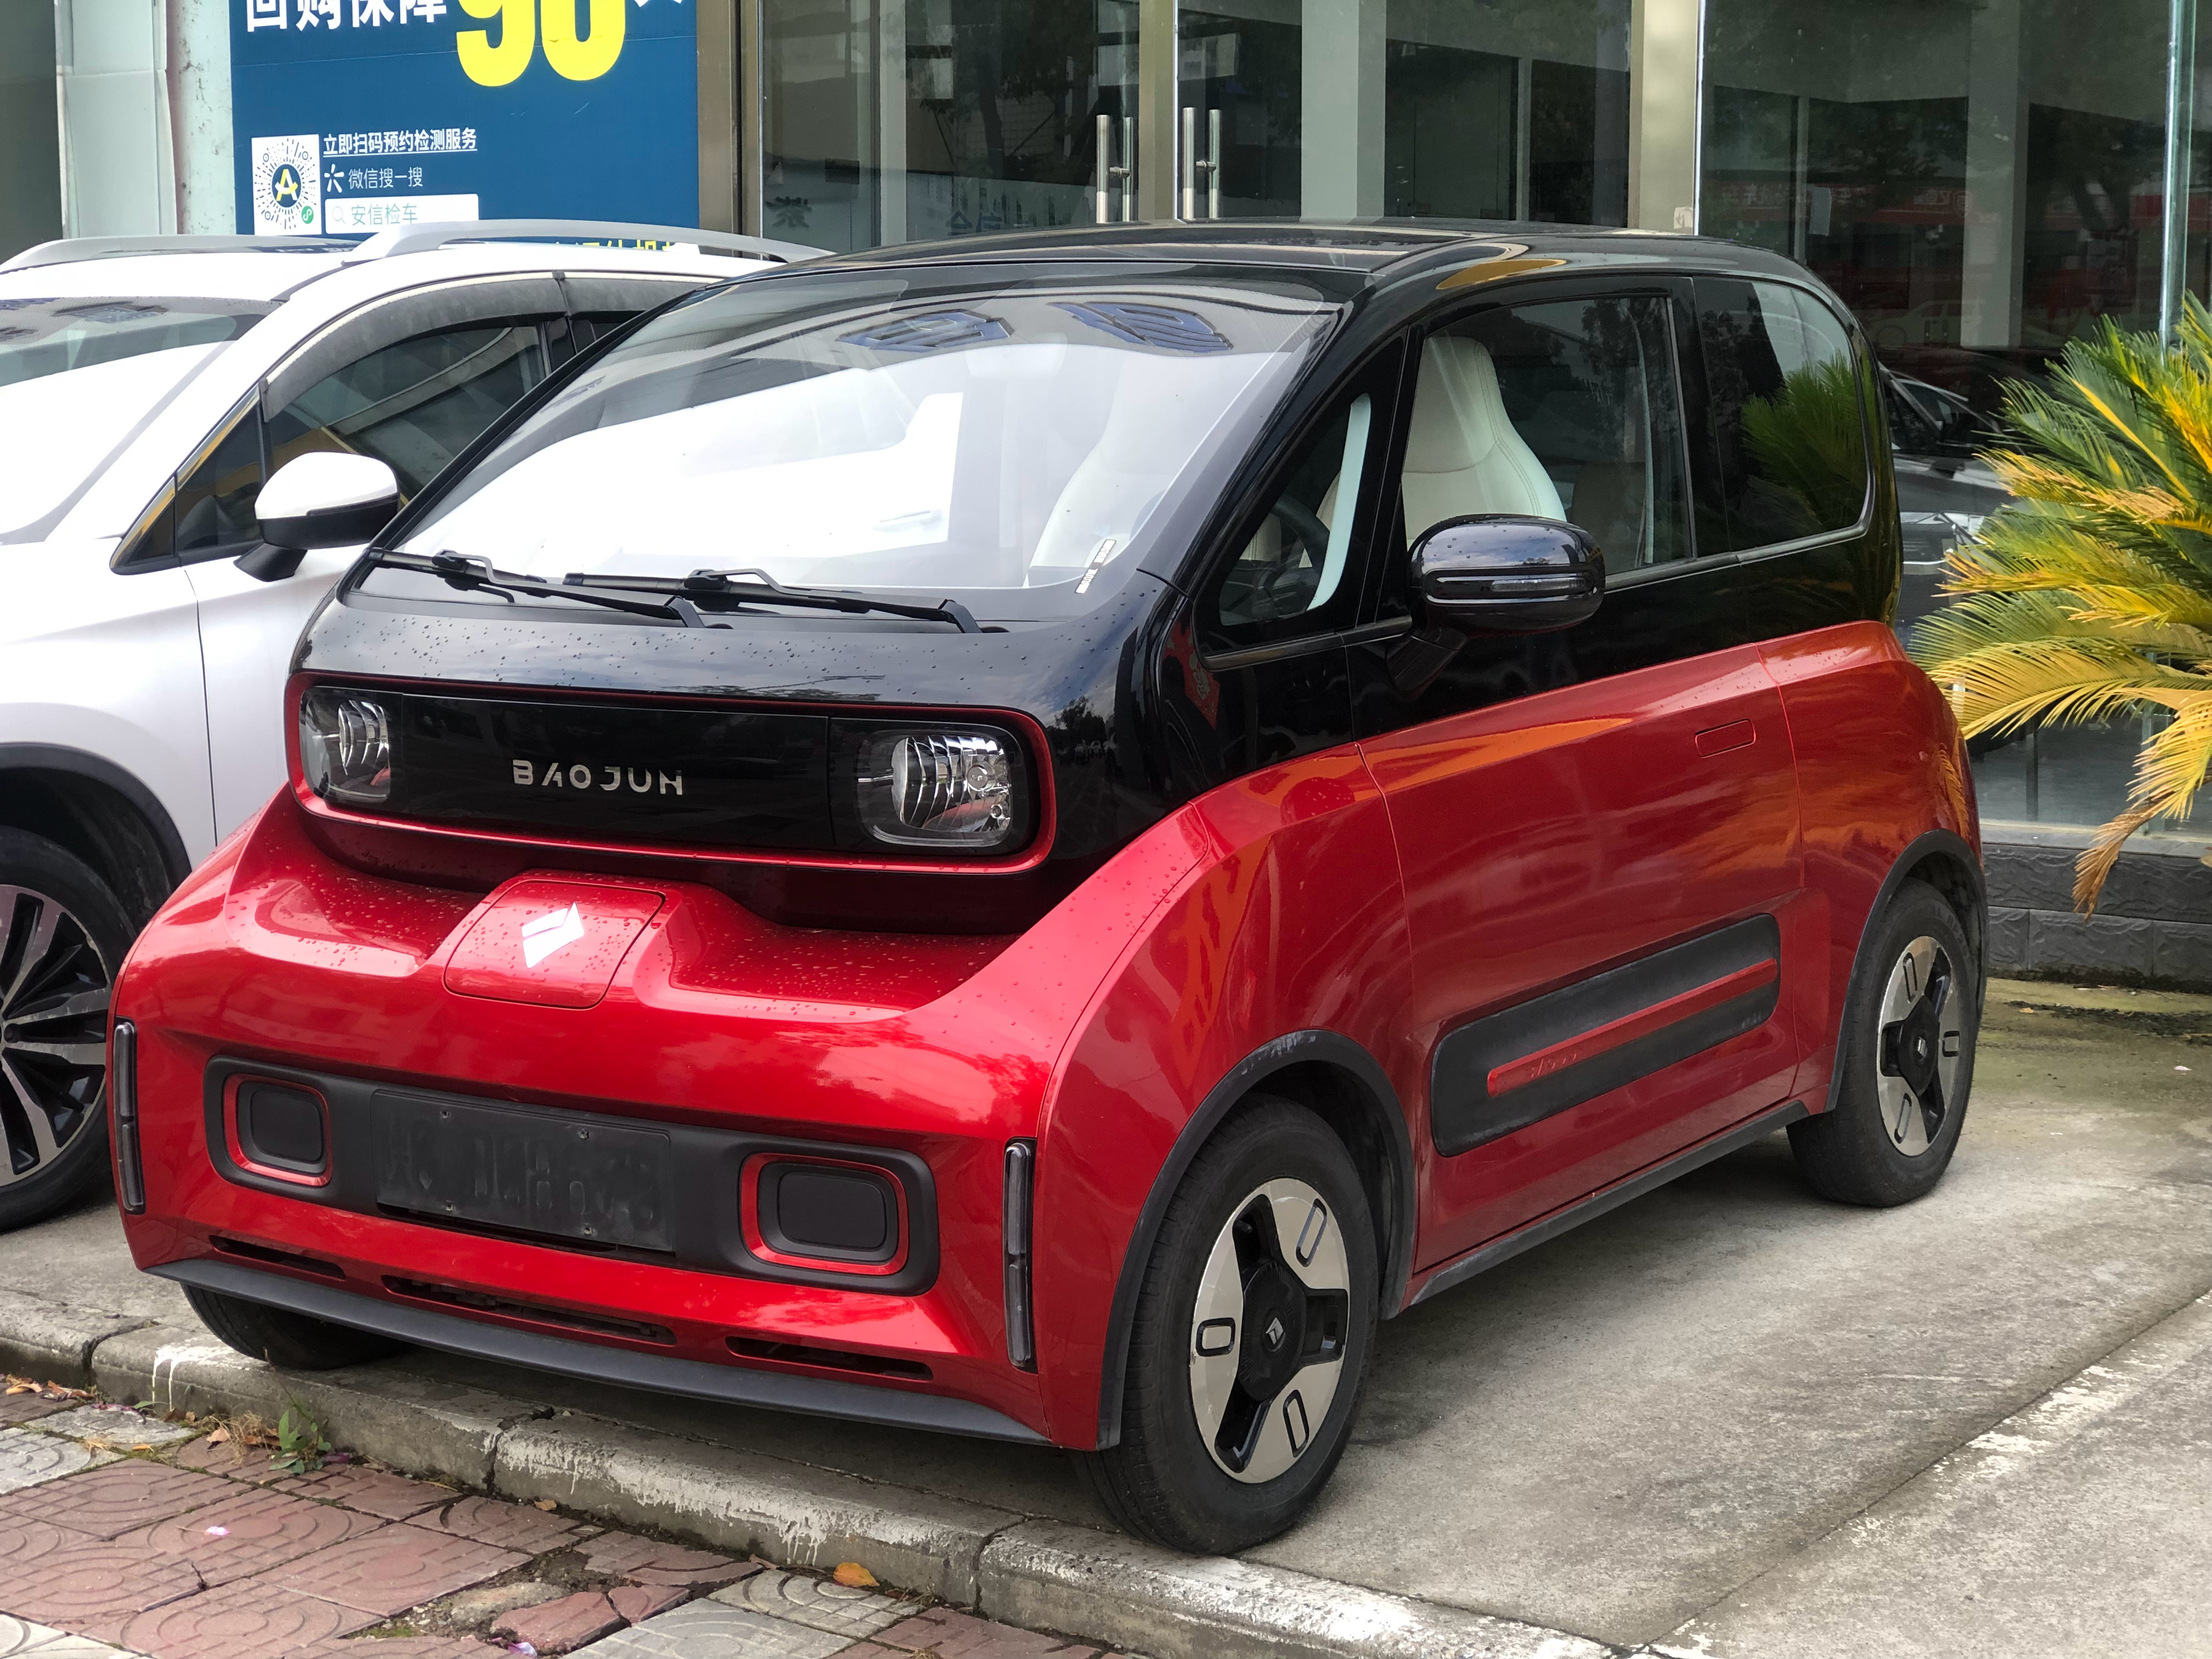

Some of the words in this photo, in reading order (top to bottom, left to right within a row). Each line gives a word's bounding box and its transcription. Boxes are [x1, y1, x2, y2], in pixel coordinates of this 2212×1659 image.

[323, 127, 477, 155] 立即扫码预约检测服务
[348, 167, 423, 189] 微信搜一搜
[351, 203, 418, 225] 安信检车
[512, 759, 682, 795] BAOJUN
